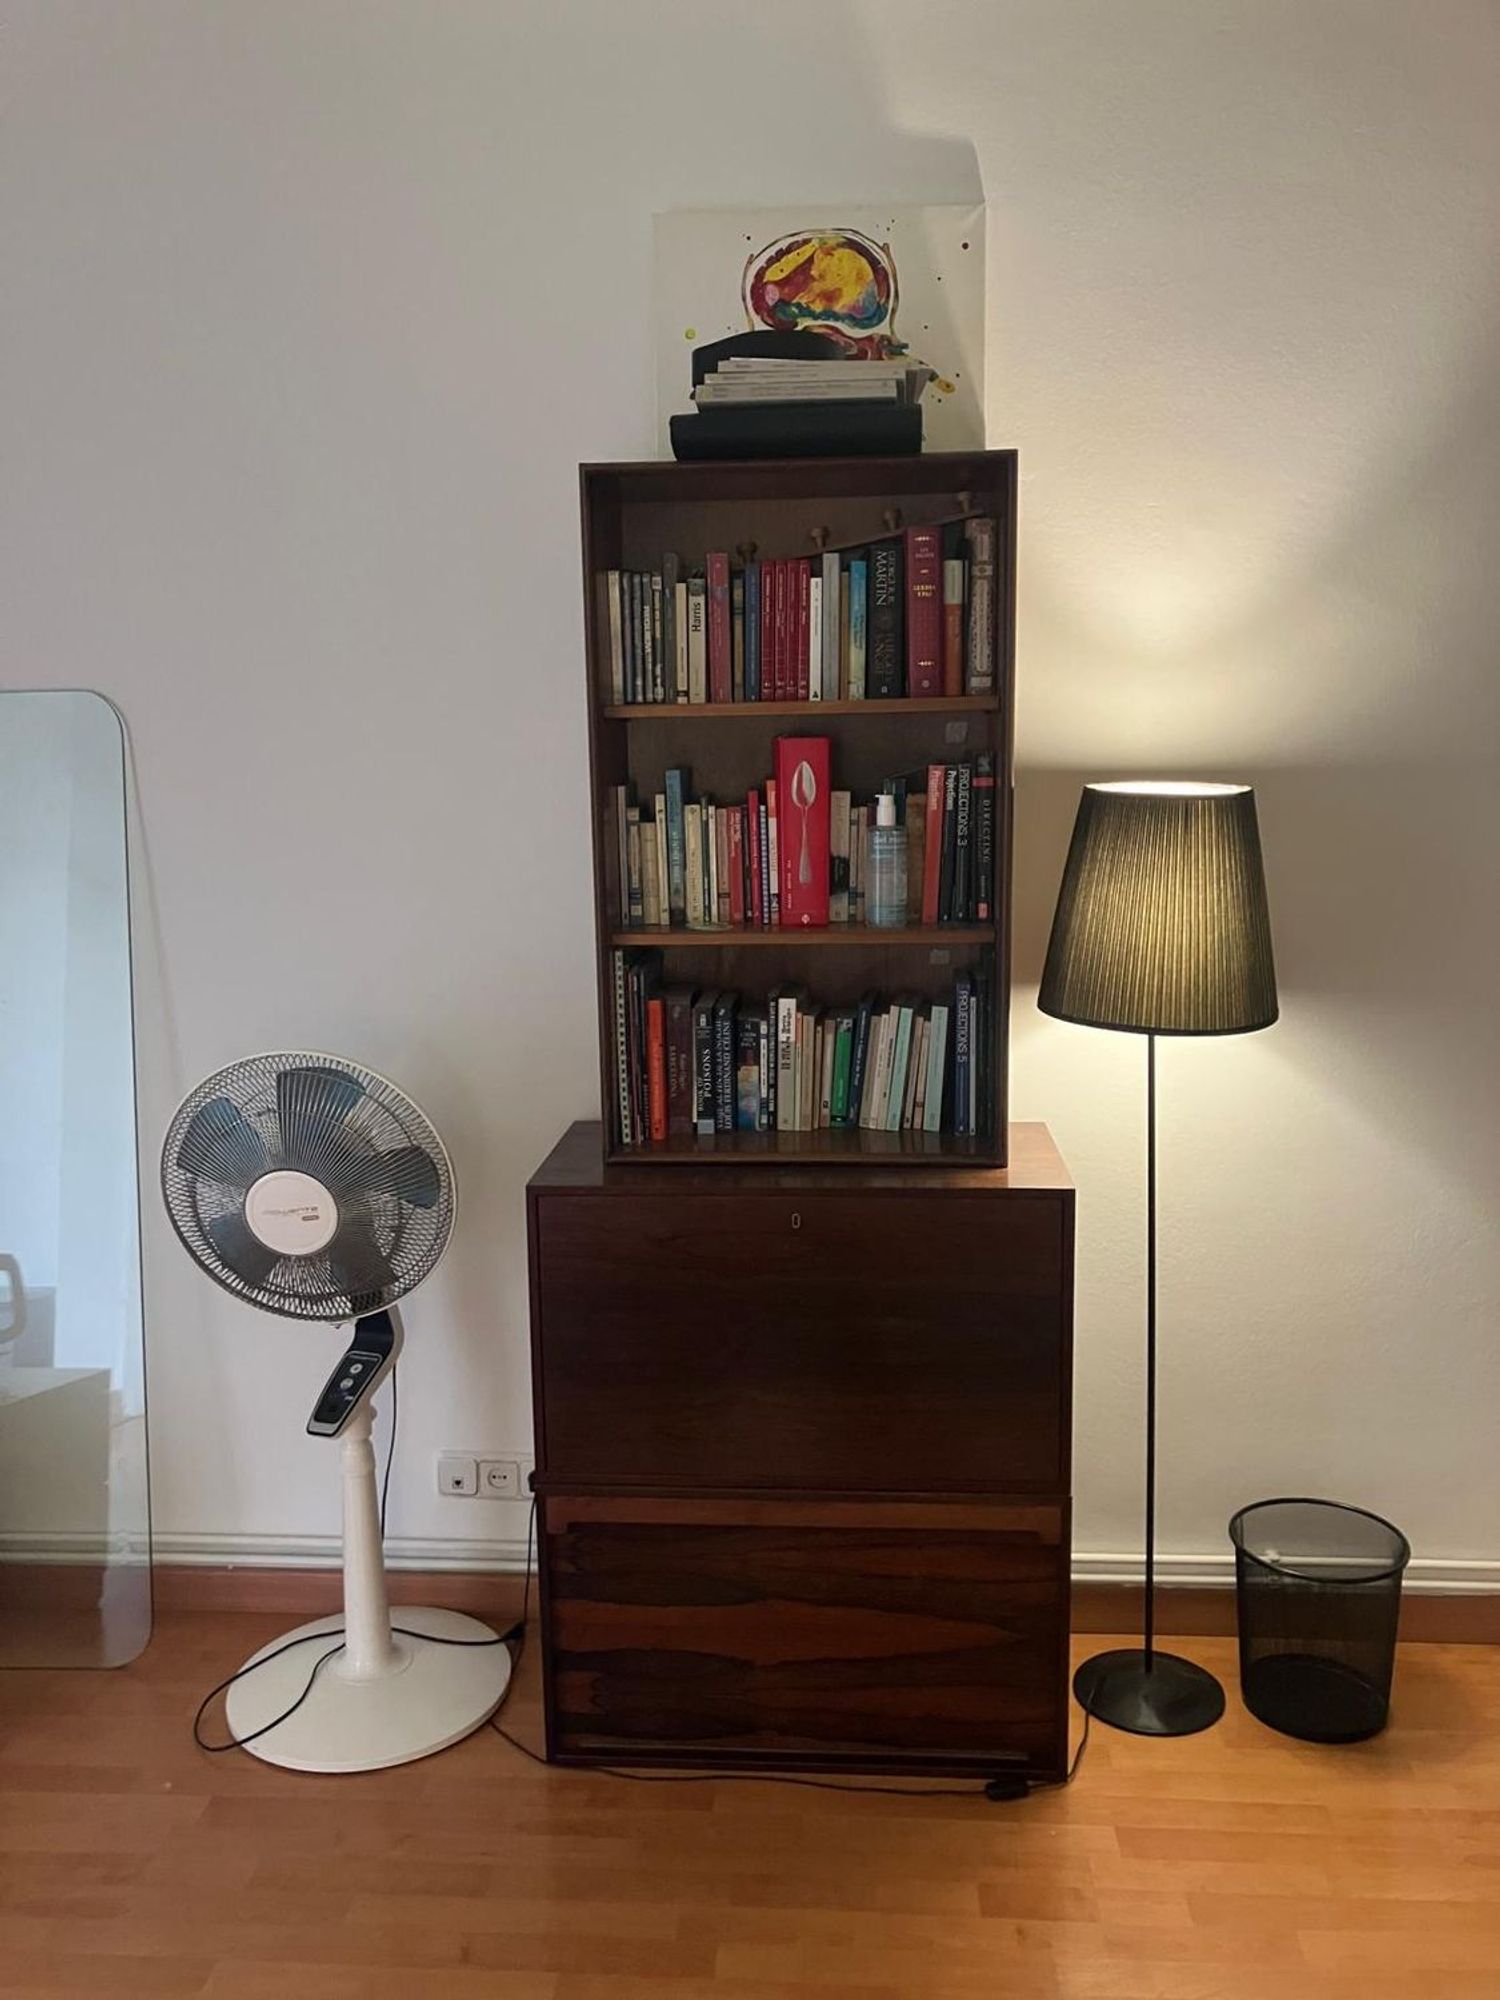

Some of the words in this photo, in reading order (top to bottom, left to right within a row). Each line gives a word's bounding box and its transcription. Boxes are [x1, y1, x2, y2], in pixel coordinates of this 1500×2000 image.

[876, 551, 888, 606] MARTIN
[691, 602, 702, 633] Harris
[946, 770, 957, 811] Projections
[958, 768, 970, 836] PROJECTIONS
[957, 989, 969, 1054] PROJECTIONS
[703, 1047, 712, 1098] POISONS
